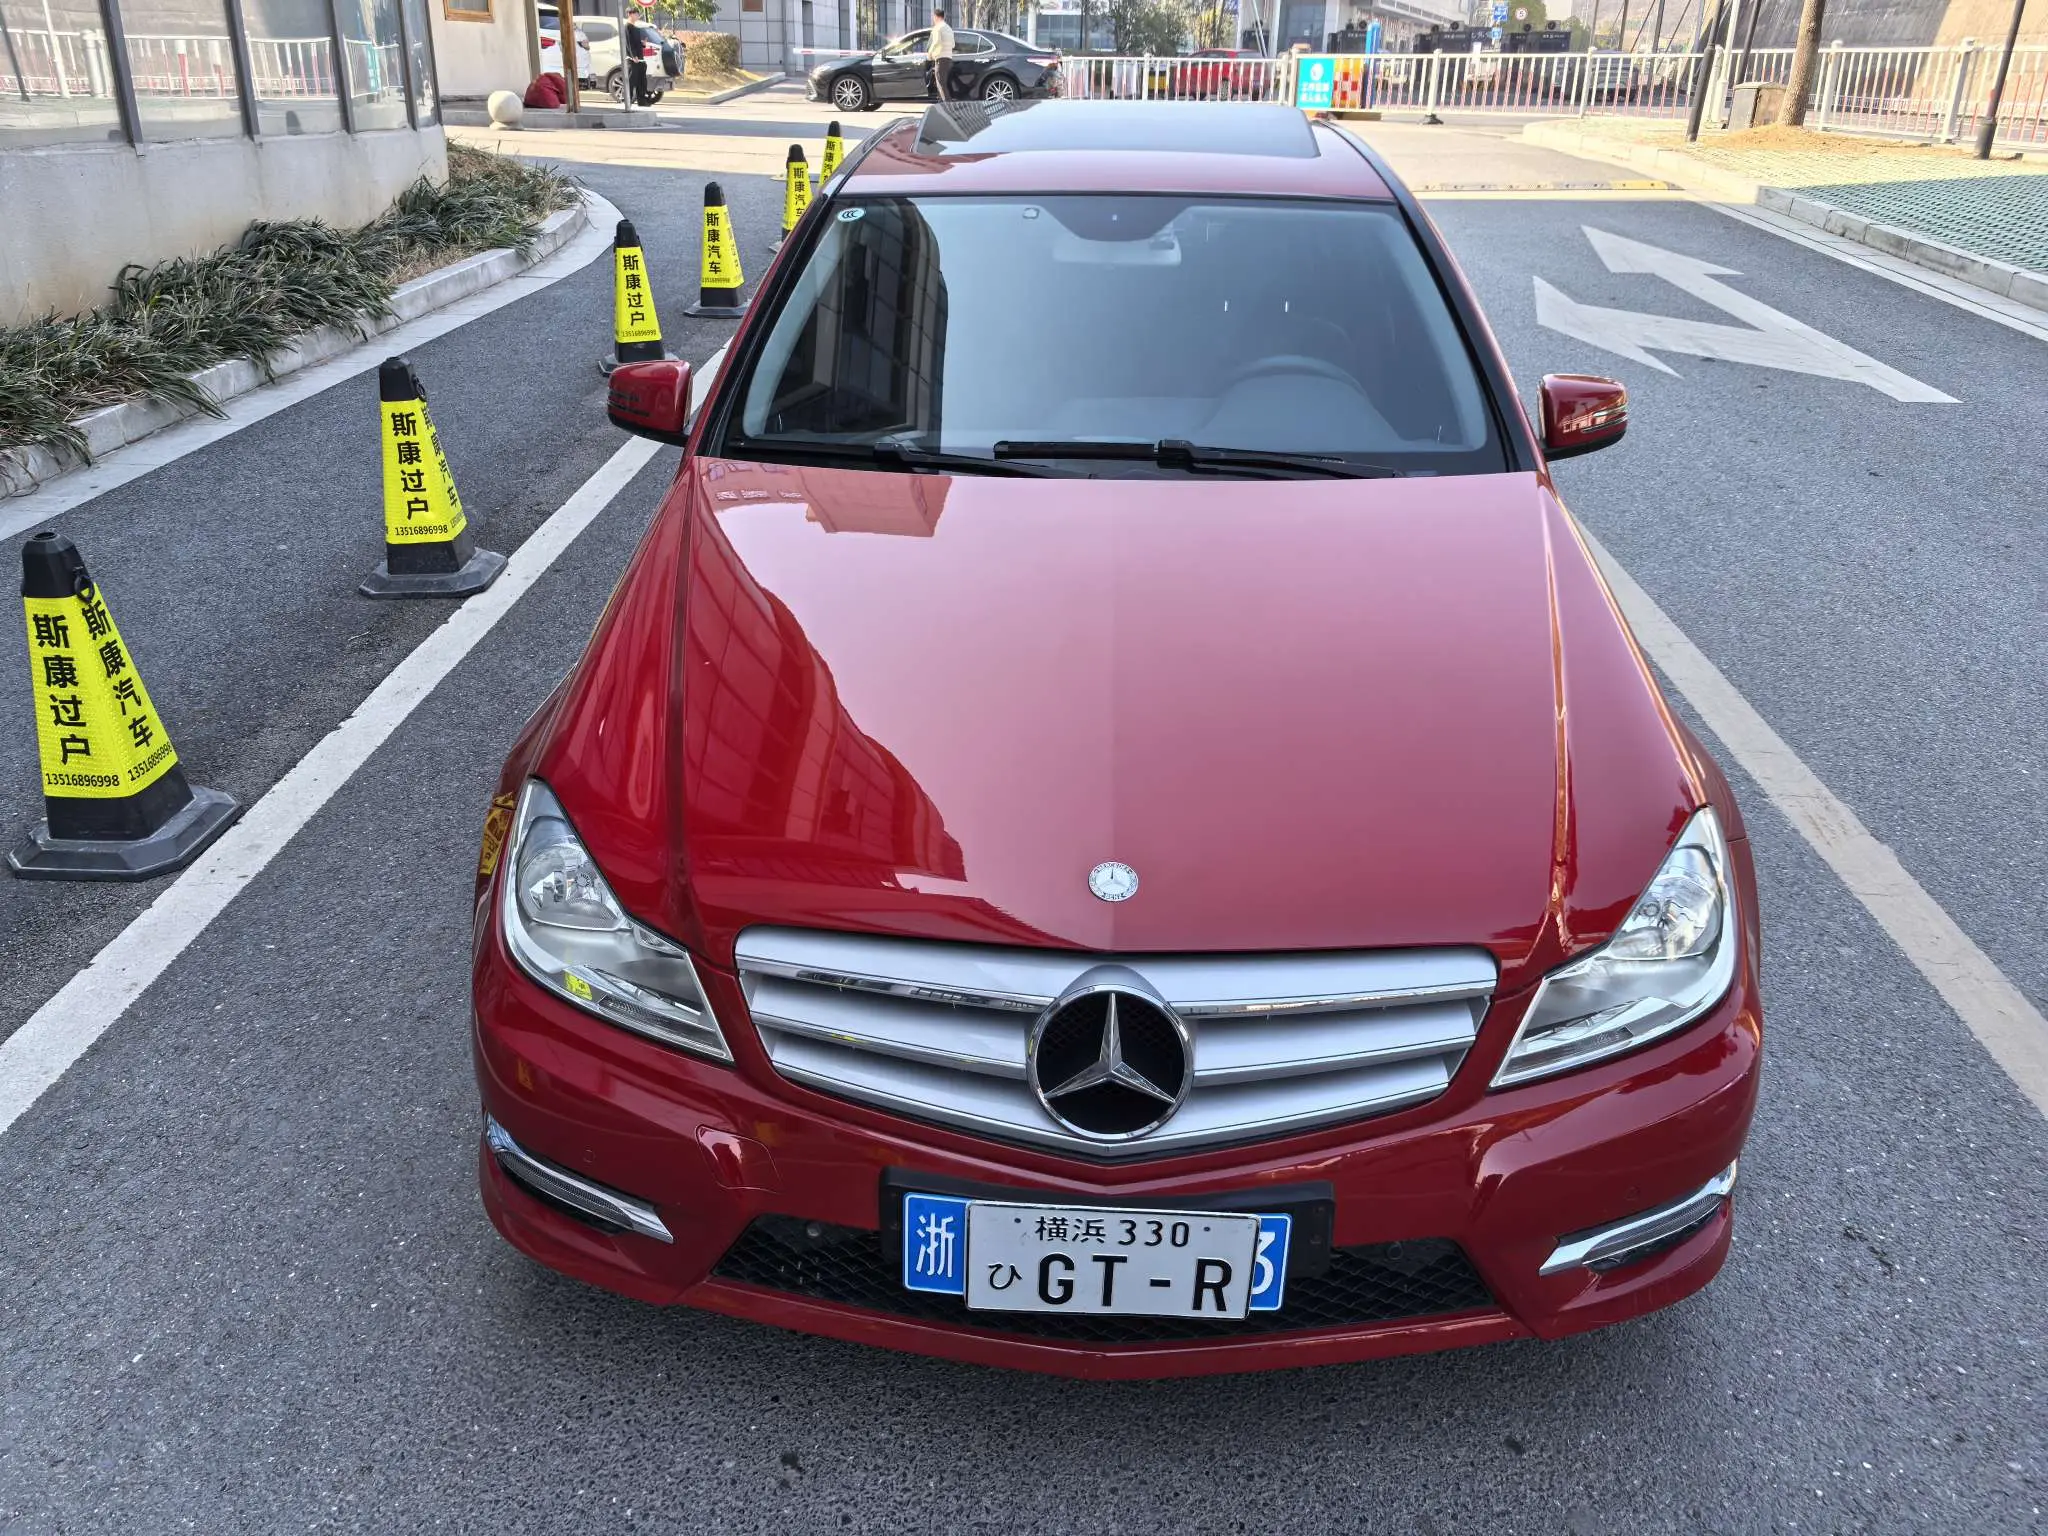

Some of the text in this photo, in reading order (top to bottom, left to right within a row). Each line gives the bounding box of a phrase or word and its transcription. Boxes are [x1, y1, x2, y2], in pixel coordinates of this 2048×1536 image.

[706, 211, 722, 275] 斯康汽车
[622, 254, 646, 327] 斯康过户
[390, 411, 430, 521] 斯康过户
[394, 524, 449, 537] 13516896998
[31, 613, 94, 766] 斯康过户
[81, 598, 154, 749] 斯康汽车
[45, 771, 121, 789] 13516896998
[915, 1212, 954, 1279] 浙
